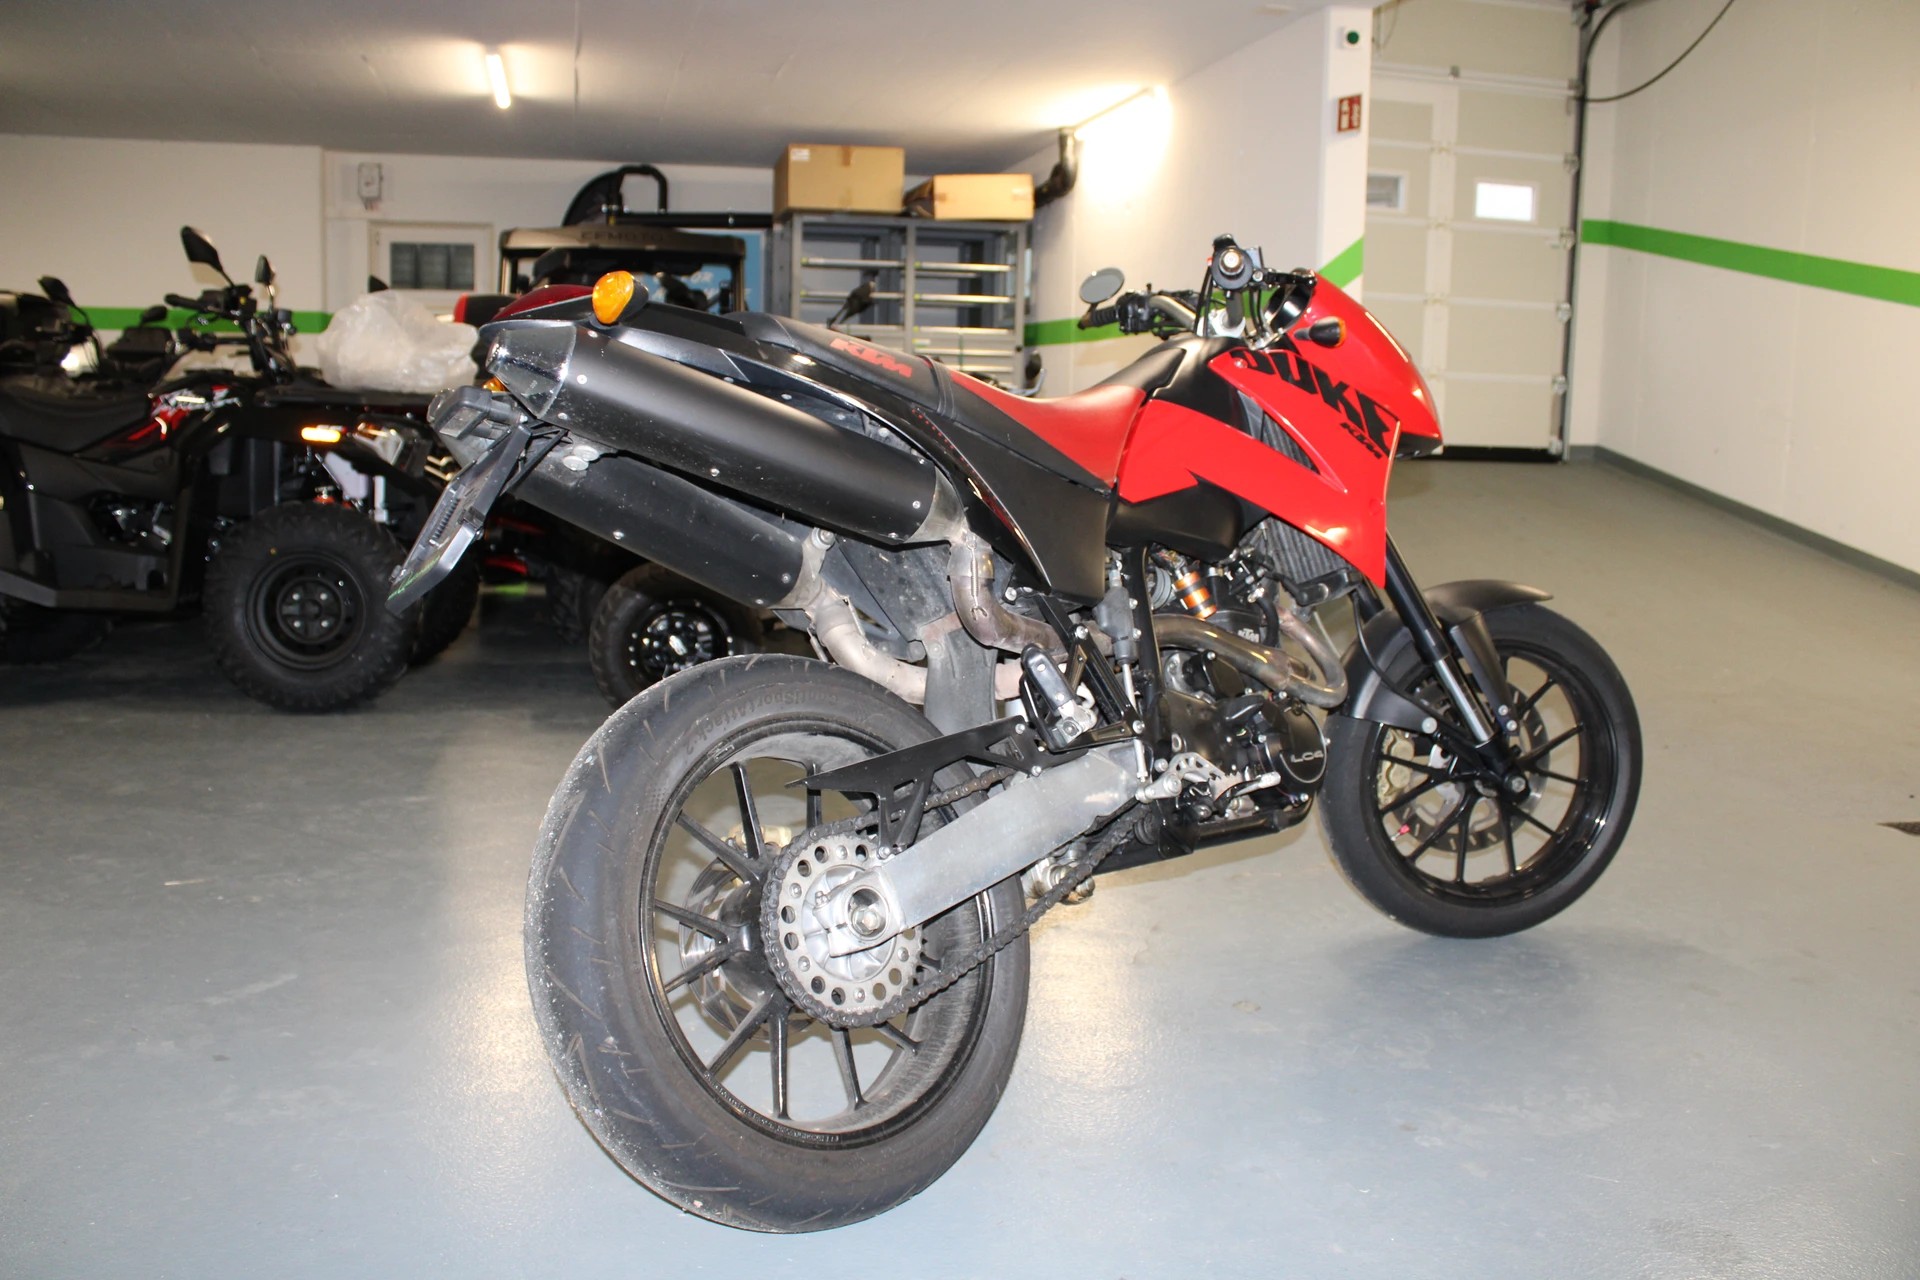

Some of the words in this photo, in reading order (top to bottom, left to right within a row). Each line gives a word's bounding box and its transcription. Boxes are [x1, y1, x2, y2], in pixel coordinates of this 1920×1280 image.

[829, 338, 912, 378] KTM
[1230, 351, 1399, 458] DUKE
[1340, 422, 1382, 459] KTM
[1238, 628, 1260, 642] KTM
